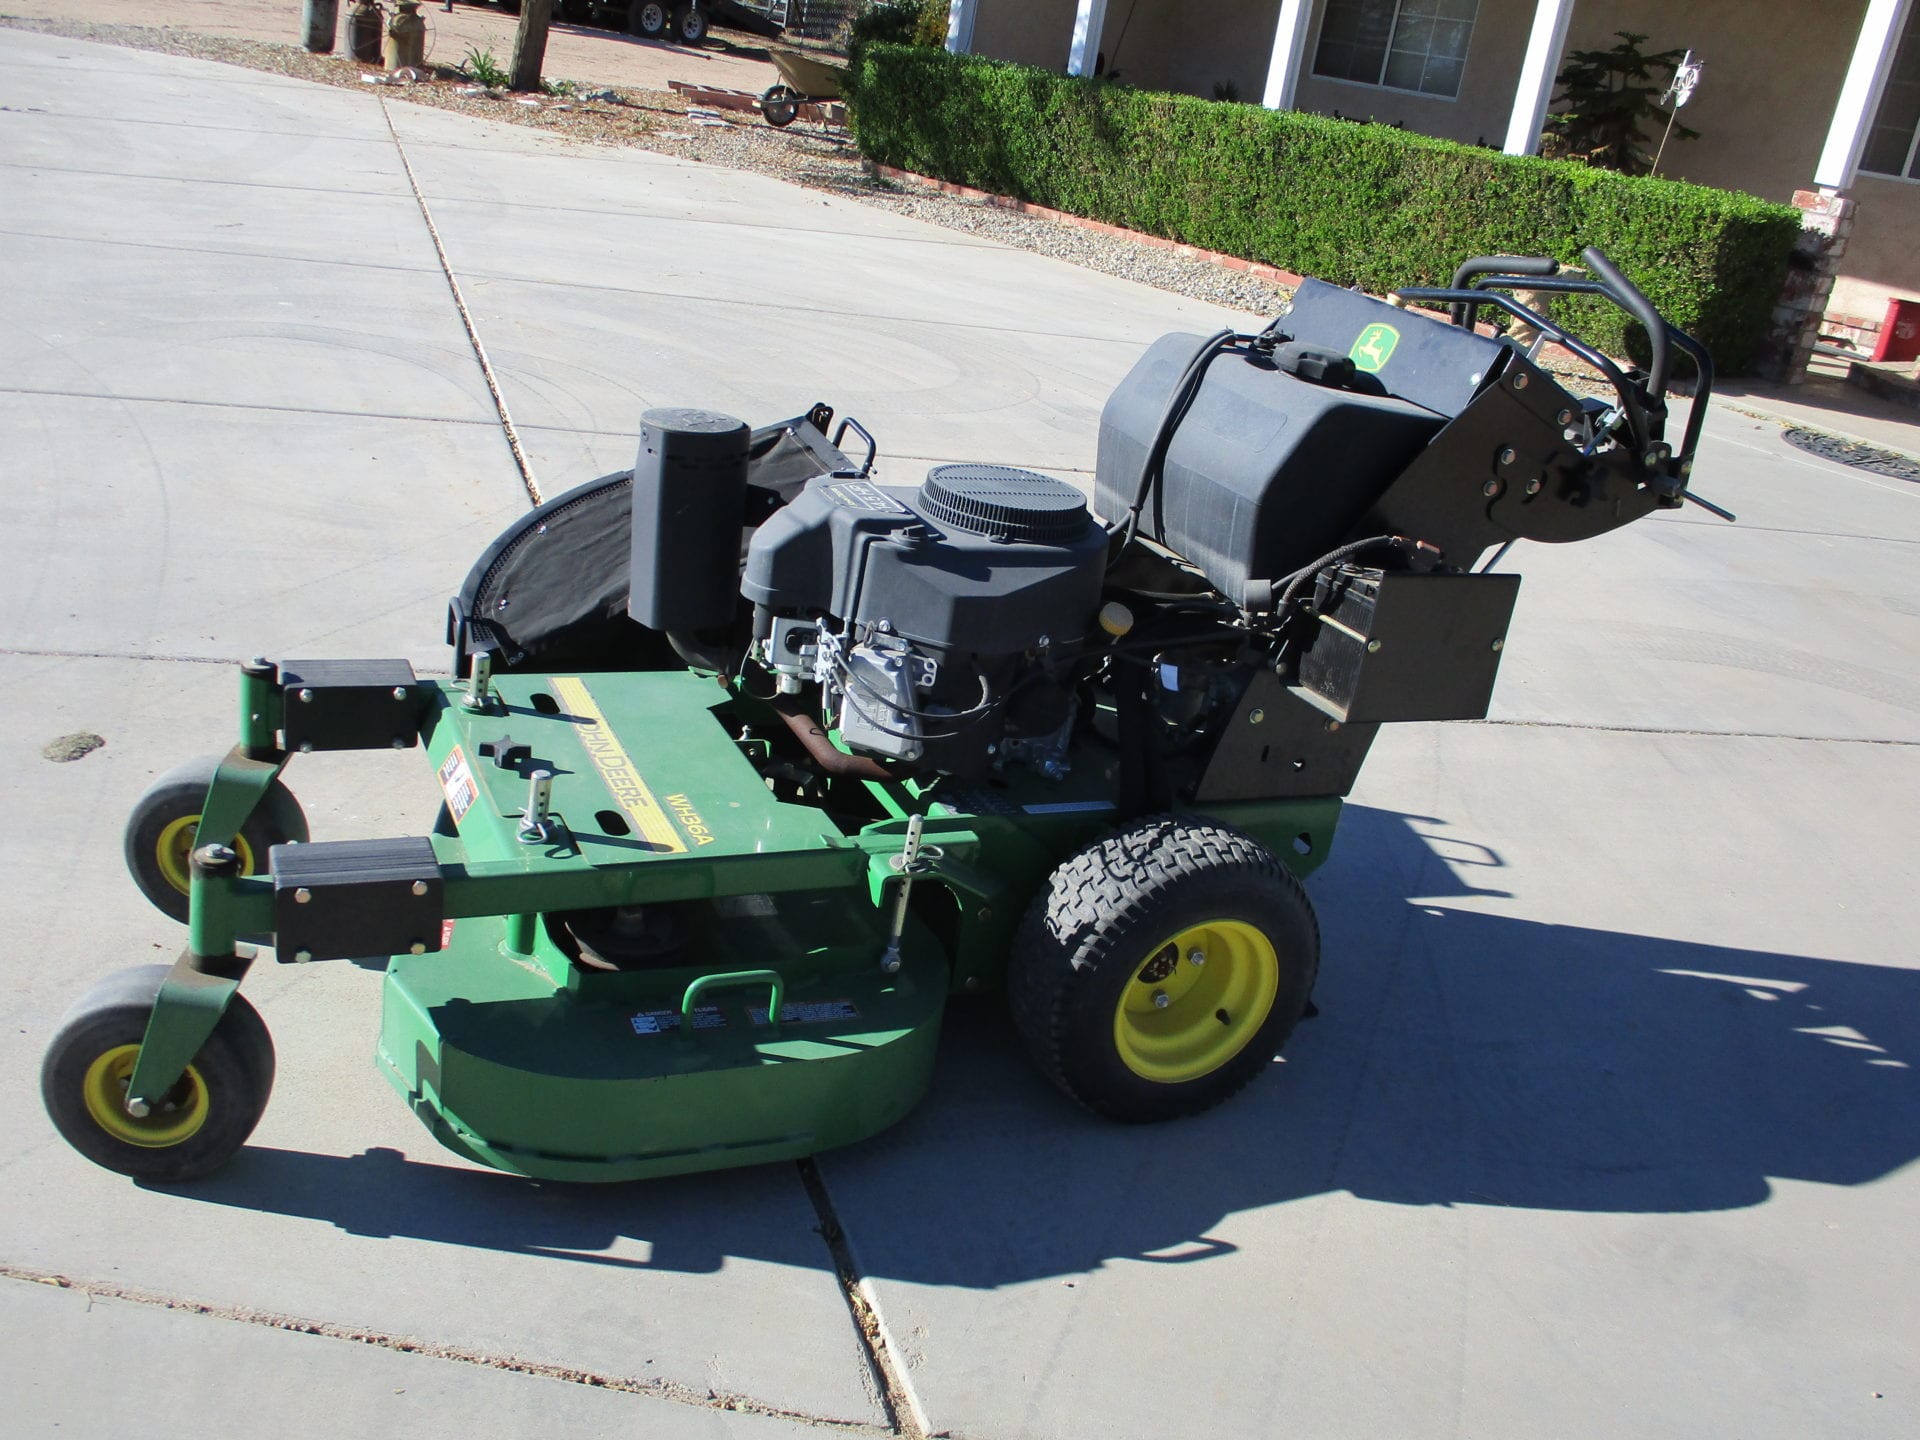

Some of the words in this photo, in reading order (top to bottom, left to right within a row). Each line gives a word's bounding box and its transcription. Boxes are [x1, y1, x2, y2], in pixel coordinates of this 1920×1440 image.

[575, 716, 614, 753] OHN
[598, 756, 648, 808] DEERE
[665, 793, 716, 846] WH36A
